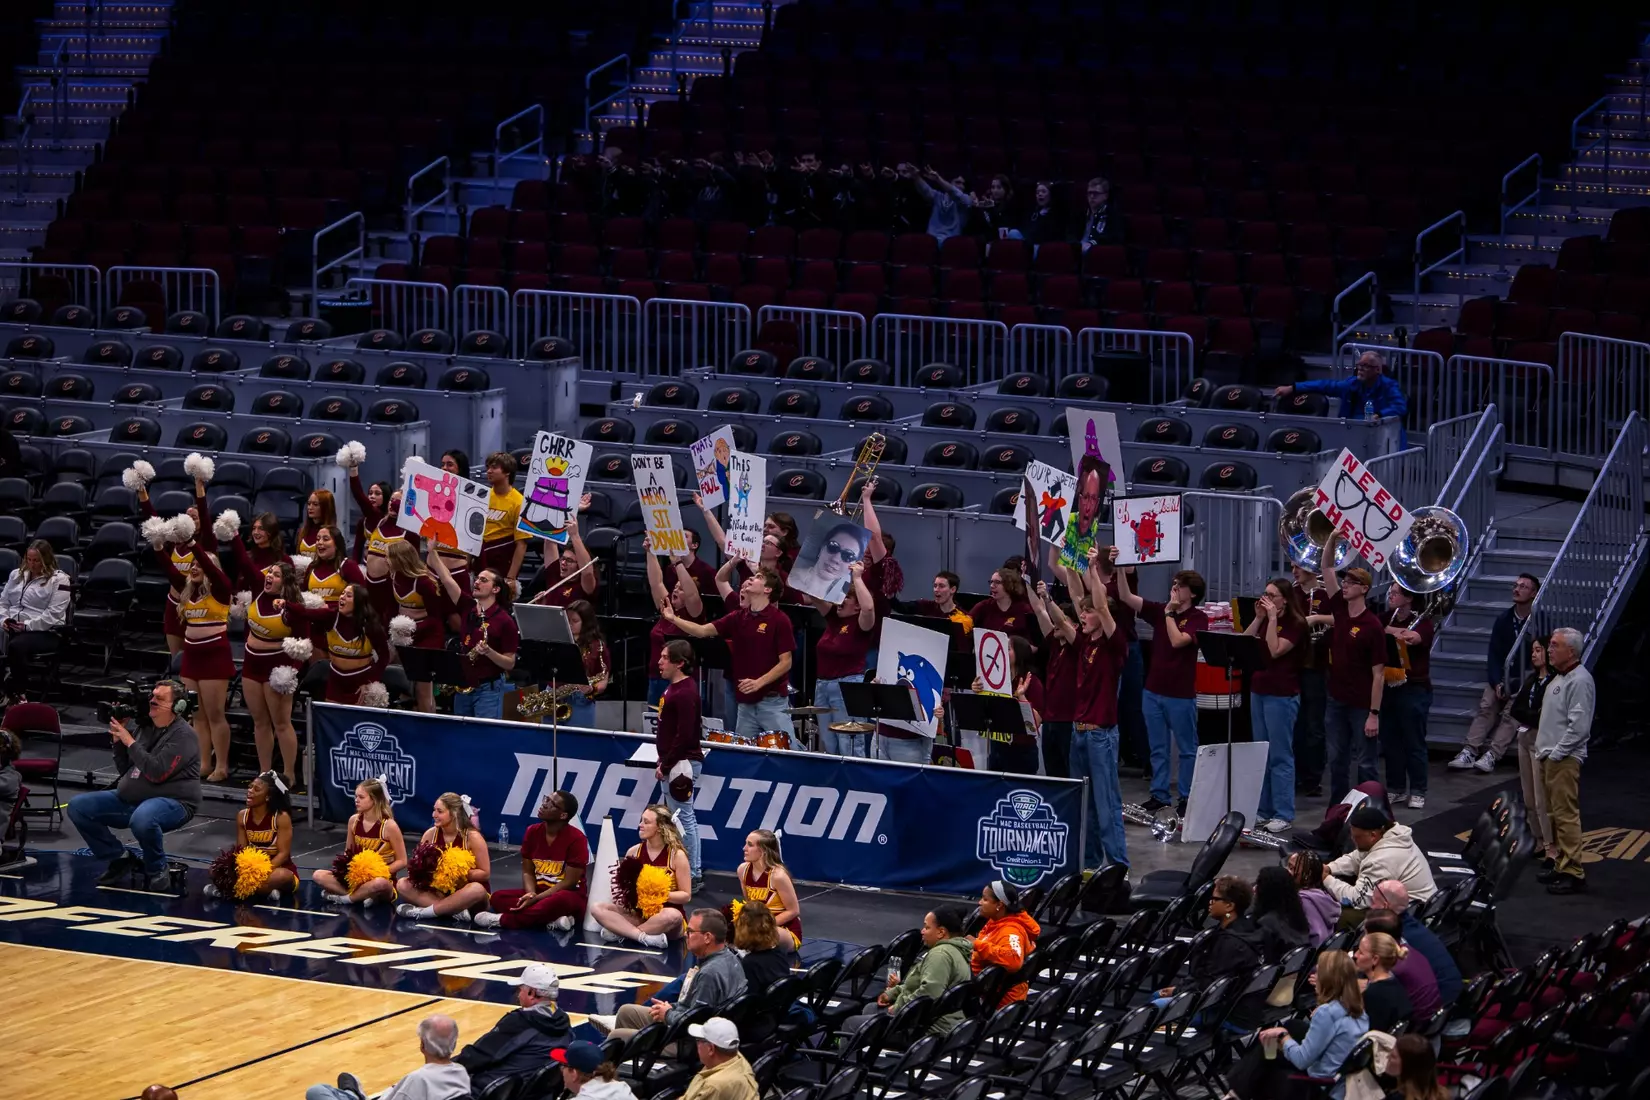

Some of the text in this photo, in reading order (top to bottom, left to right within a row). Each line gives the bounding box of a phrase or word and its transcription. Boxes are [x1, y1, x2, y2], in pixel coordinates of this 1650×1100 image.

[632, 456, 665, 470] DON'T BE
[649, 472, 657, 486] A
[700, 477, 720, 497] FOUL
[1342, 453, 1403, 521] NEED
[652, 508, 672, 529] SIT
[1316, 488, 1385, 567] THESE?
[648, 529, 687, 551] DOWN
[185, 608, 209, 618] CMU
[362, 752, 394, 761] BASKETBALL
[334, 756, 411, 790] TOURNAMENT
[1013, 821, 1049, 830] BASKETBALL
[982, 826, 1065, 859] TOURNAMENT
